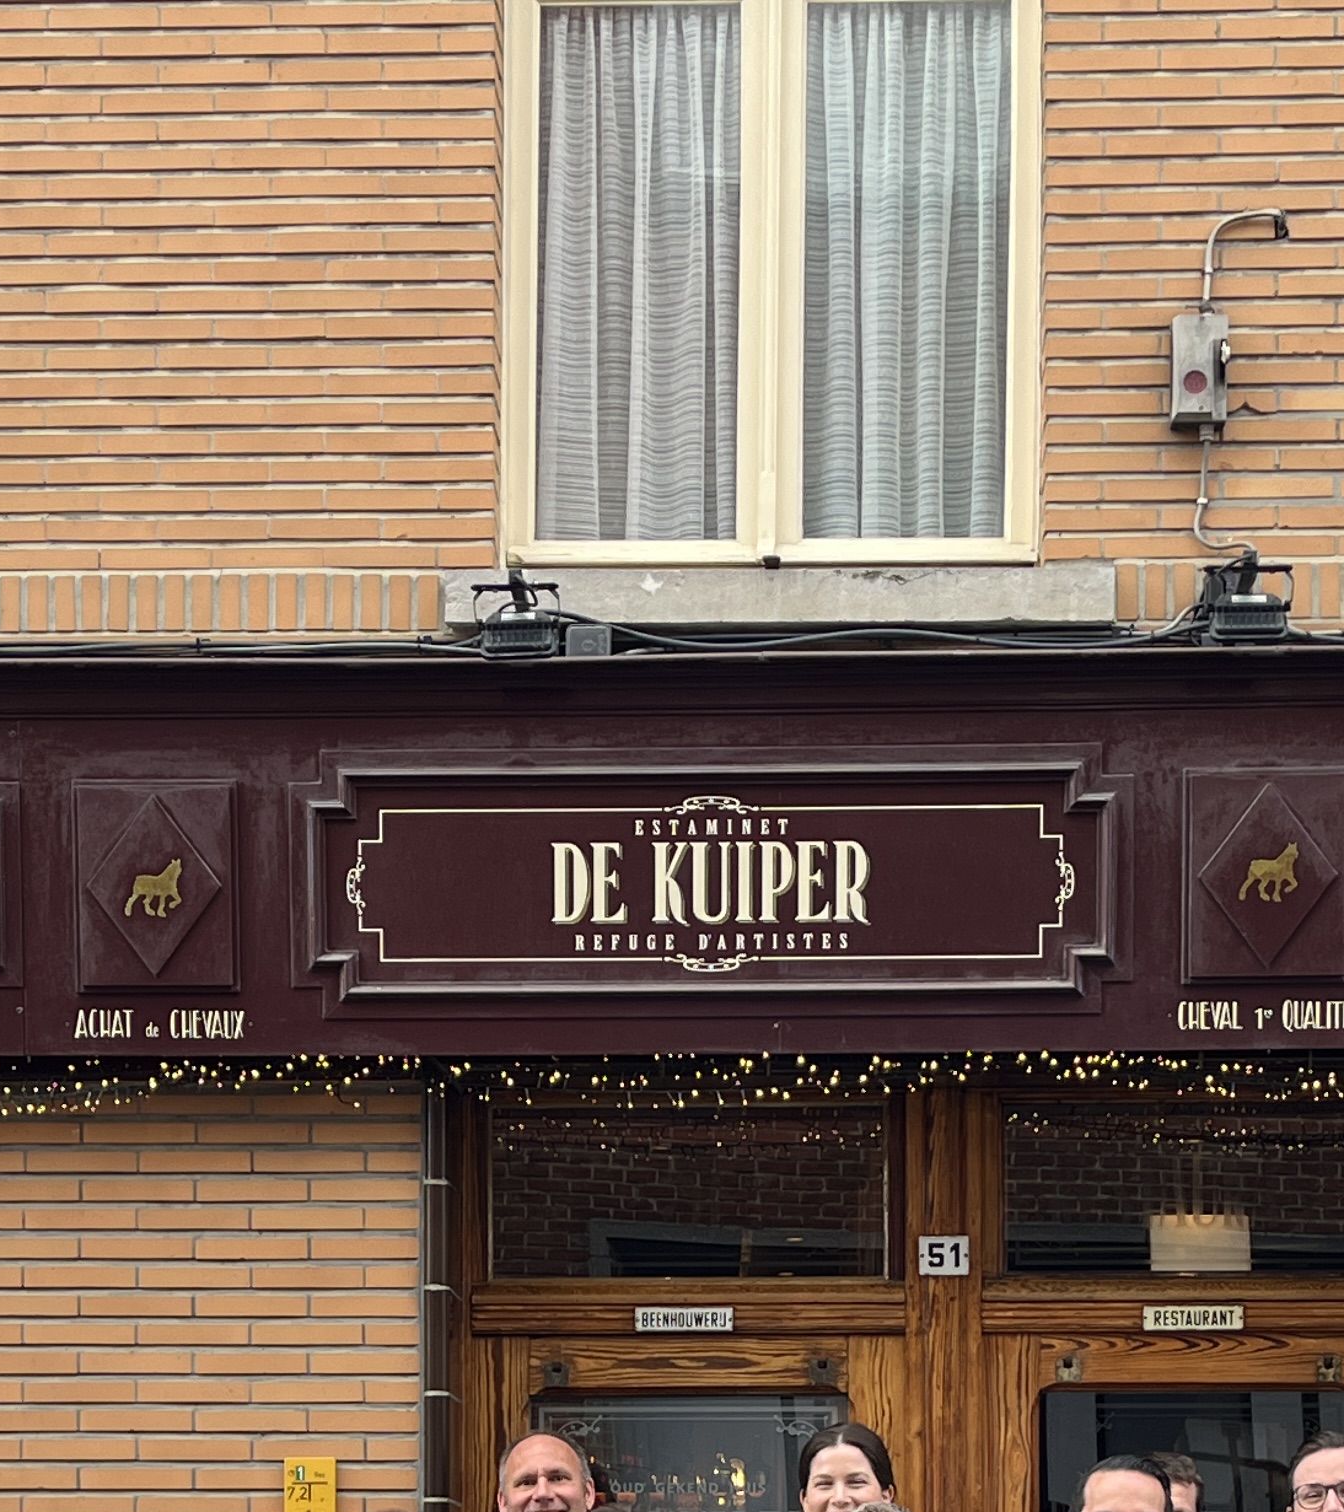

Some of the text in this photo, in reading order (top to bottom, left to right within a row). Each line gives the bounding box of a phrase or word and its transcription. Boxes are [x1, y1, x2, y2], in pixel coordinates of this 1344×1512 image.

[634, 818, 789, 836] ESTAMINET
[550, 840, 871, 927] DE KUIPER
[574, 932, 848, 952] REFUGE D'ARTISTES
[74, 1008, 245, 1040] ACHAT de CHEVAUX
[1177, 1000, 1244, 1031] CHEVAL
[928, 1242, 960, 1268] 51
[1153, 1310, 1235, 1326] RESTAURANT
